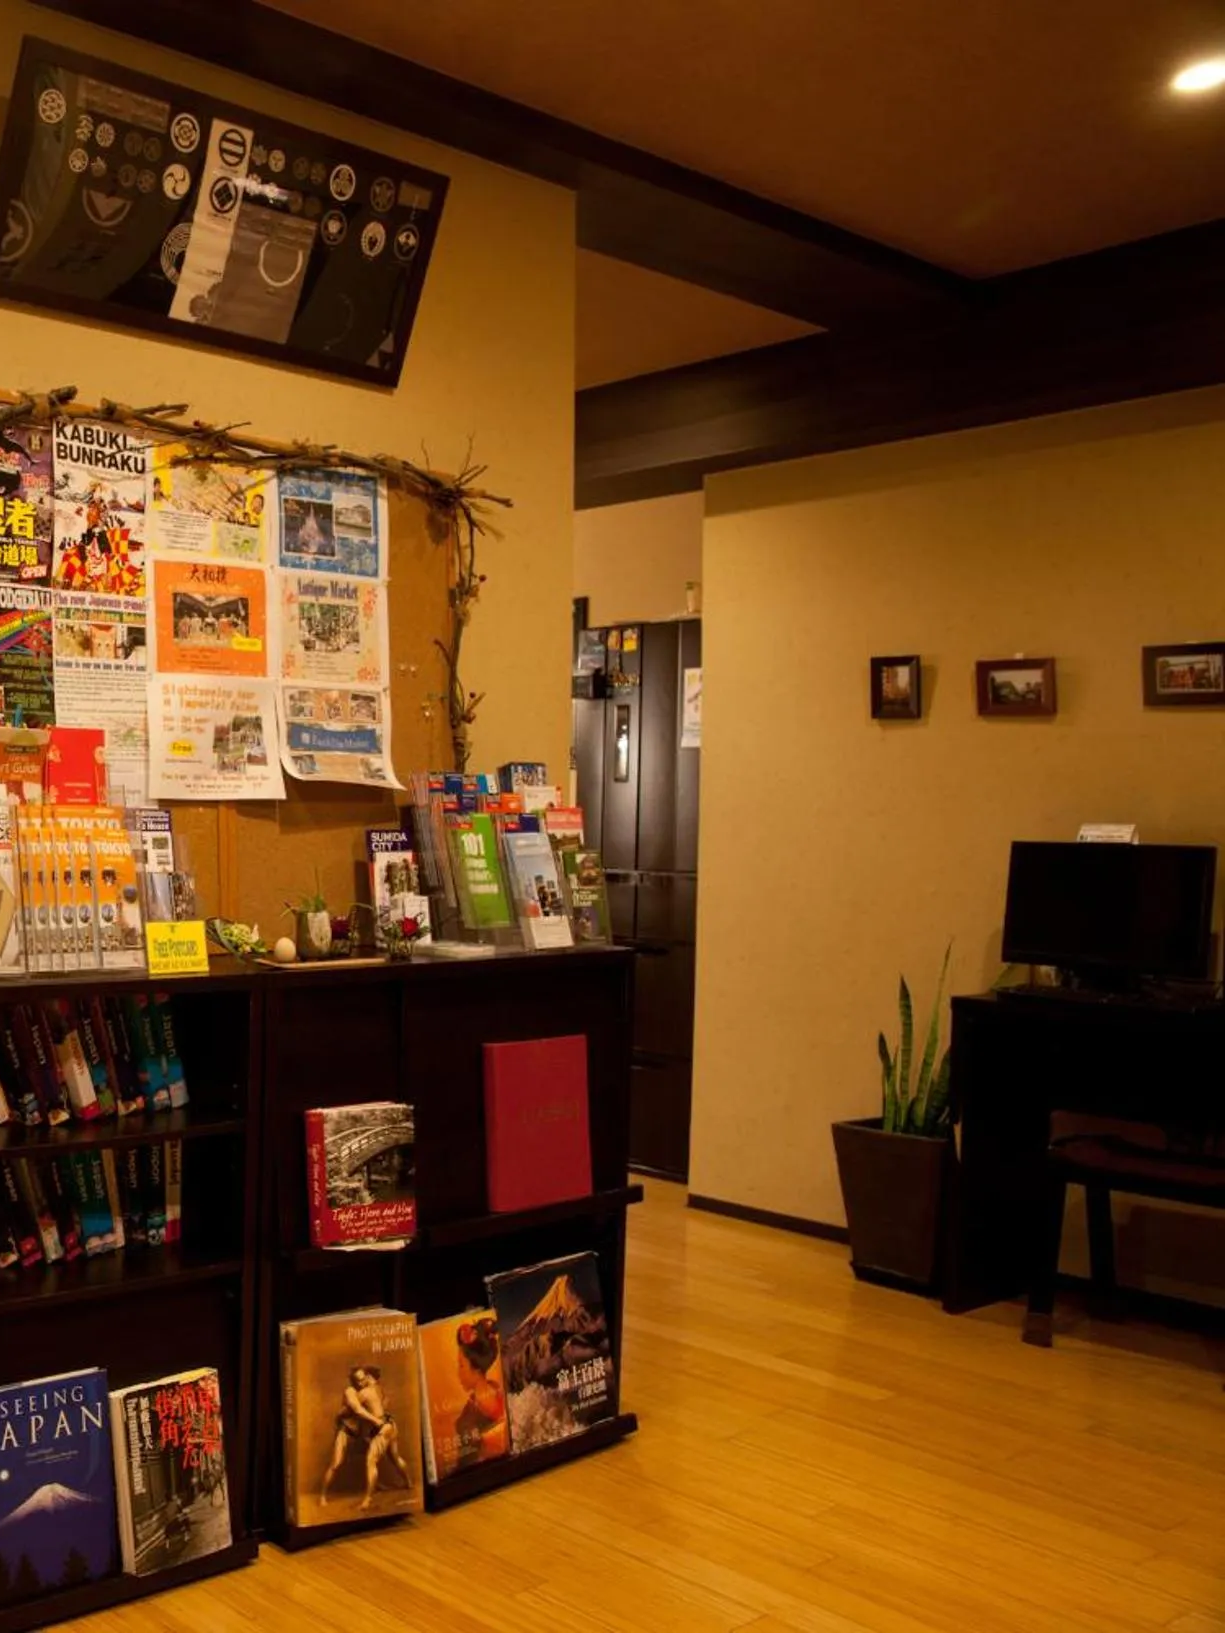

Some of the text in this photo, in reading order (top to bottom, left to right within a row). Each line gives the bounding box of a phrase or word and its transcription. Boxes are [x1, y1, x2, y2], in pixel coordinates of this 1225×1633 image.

[55, 421, 127, 451] KABUKI
[55, 441, 146, 474] BUNRAKU
[370, 831, 408, 843] SUMIDA
[461, 832, 486, 856] 101
[94, 841, 131, 855] TOKYO
[371, 842, 394, 852] CITY
[347, 1321, 414, 1340] PHOTOGRAPHY
[371, 1336, 413, 1353] IN JAPAN
[0, 1385, 85, 1419] SEEING
